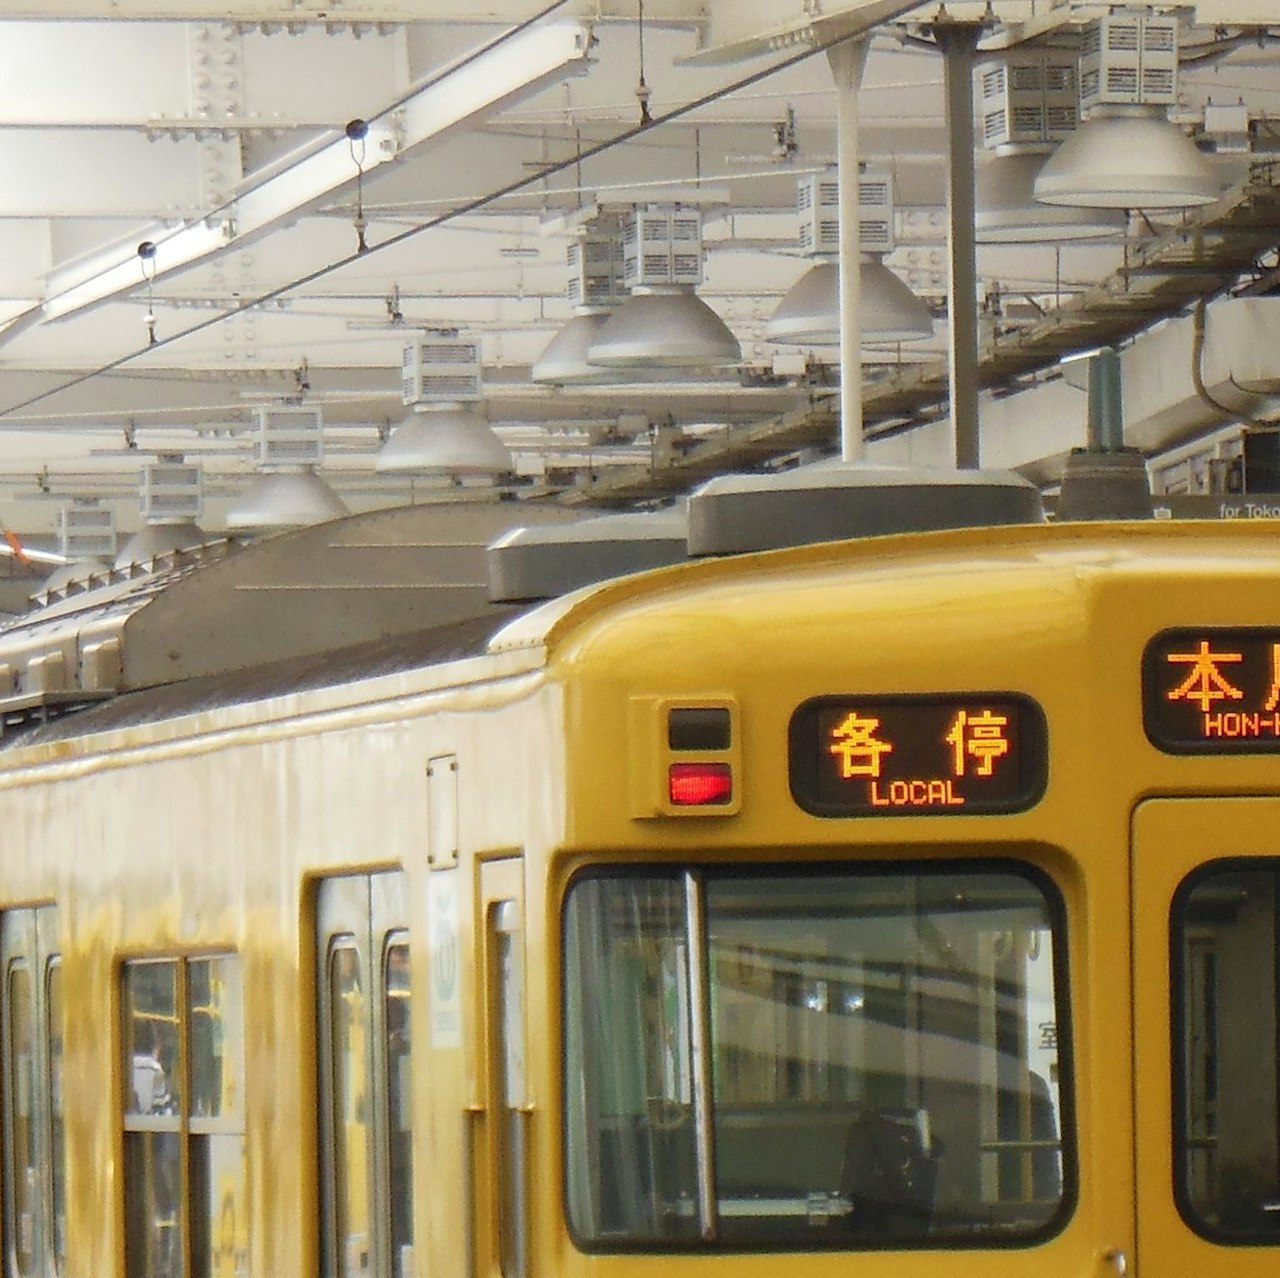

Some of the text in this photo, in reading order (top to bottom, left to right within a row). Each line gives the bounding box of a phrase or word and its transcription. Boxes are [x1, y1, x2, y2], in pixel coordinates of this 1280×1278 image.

[1219, 503, 1240, 519] for
[829, 709, 1010, 778] 各停
[871, 779, 965, 806] LOCAL
